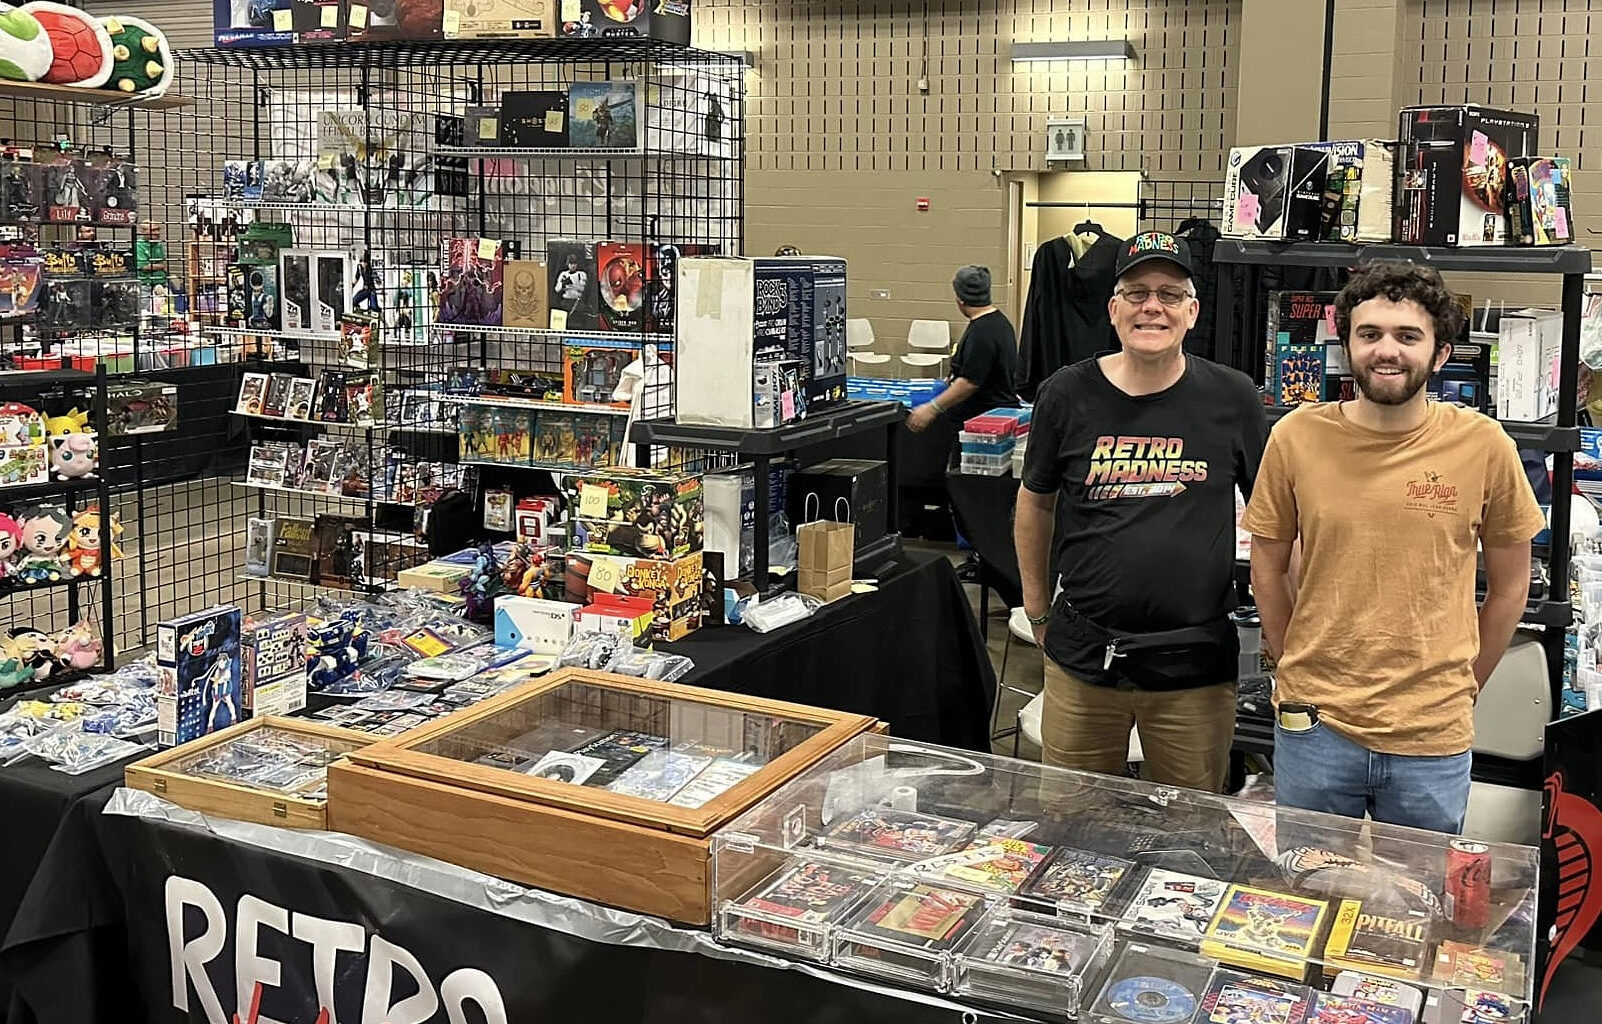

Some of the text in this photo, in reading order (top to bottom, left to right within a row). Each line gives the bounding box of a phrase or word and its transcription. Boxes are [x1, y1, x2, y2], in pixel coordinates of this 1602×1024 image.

[322, 115, 371, 126] UNICOR
[1226, 172, 1238, 232] GAMECUBE
[1136, 232, 1174, 245] RETRO
[1128, 240, 1179, 257] MADNESS
[44, 253, 76, 268] Buffy
[93, 253, 125, 268] Buffy
[756, 279, 781, 297] ROCK
[756, 282, 788, 315] BAND 3
[1290, 303, 1322, 319] SUPER
[107, 389, 143, 399] HALO
[1091, 436, 1184, 460] RETRO
[1085, 460, 1208, 485] MADNESS
[1124, 485, 1174, 495] EST. 2014
[585, 496, 600, 505] 100
[280, 523, 312, 541] Fallout
[626, 564, 667, 590] DONKEY KONGA
[1341, 906, 1356, 926] 32X
[1356, 914, 1425, 941] PITFALL
